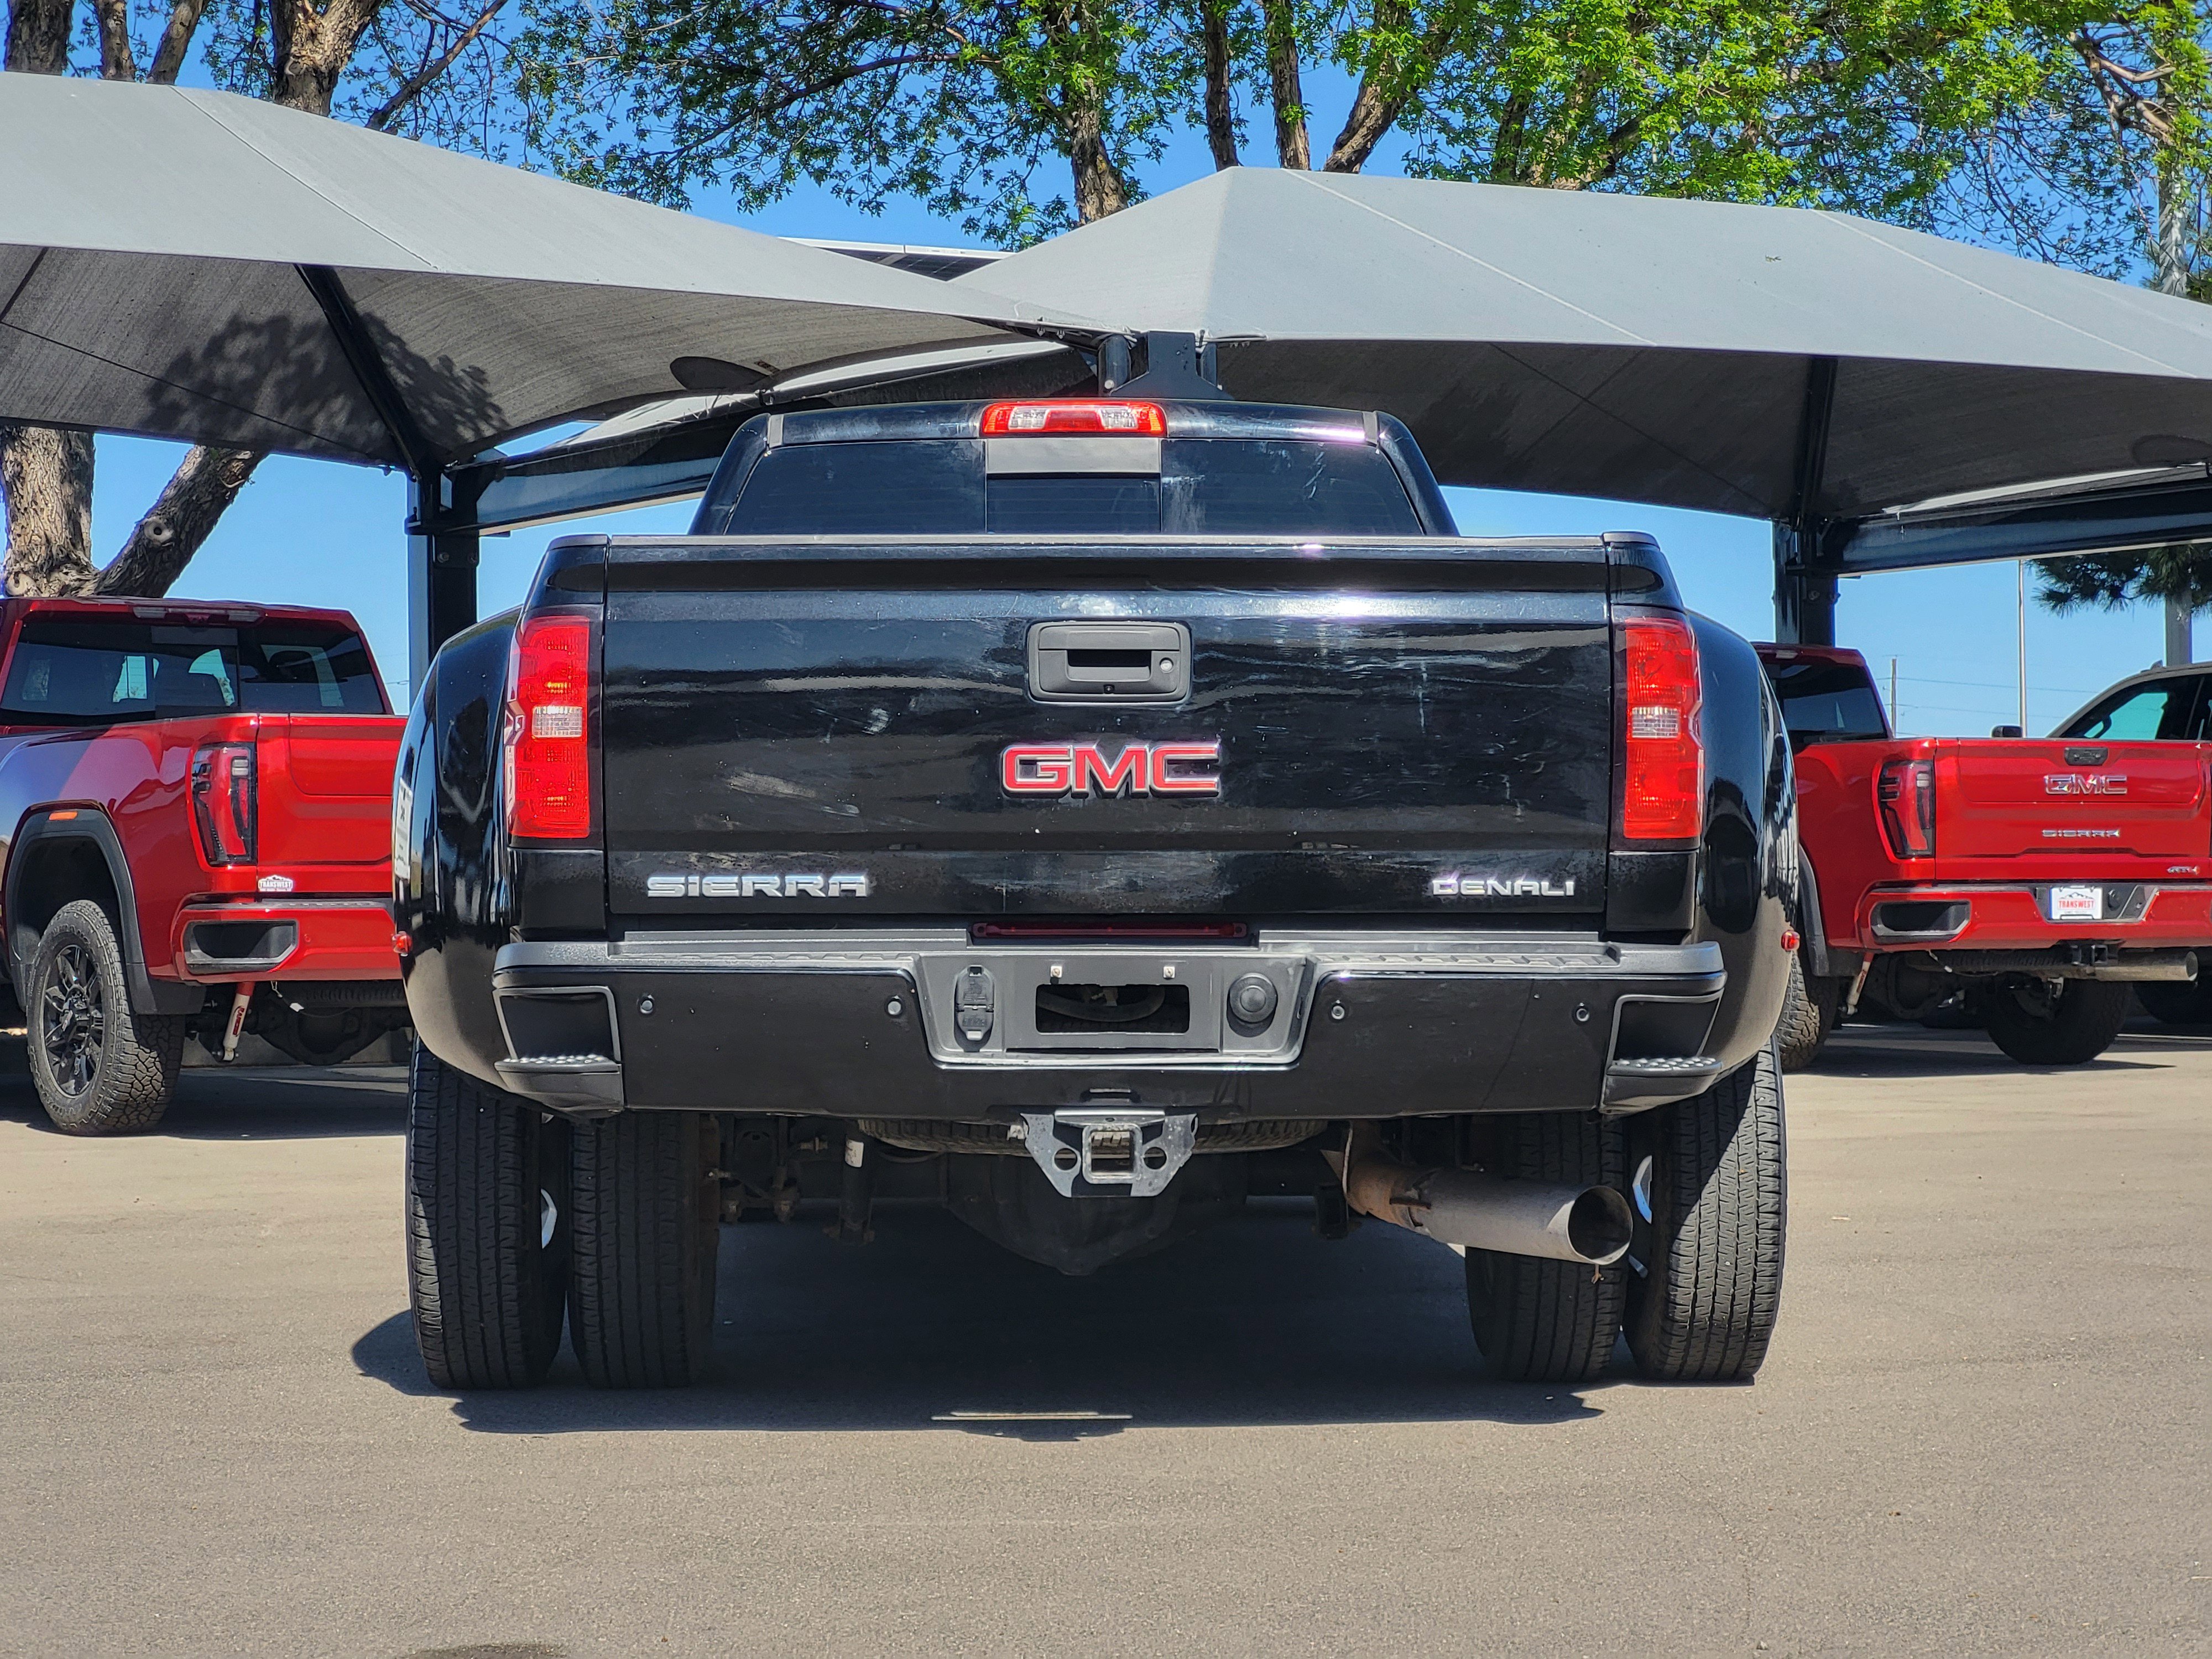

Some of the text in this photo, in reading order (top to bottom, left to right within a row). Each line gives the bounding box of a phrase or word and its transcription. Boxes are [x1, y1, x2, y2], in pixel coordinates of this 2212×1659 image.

[1001, 743, 1220, 797] GMC
[2043, 774, 2128, 795] GMC
[2042, 829, 2121, 838] SIERRA
[647, 874, 869, 898] SIERRA
[1431, 880, 1575, 897] DENALI
[2058, 899, 2095, 909] TRANSWEST
